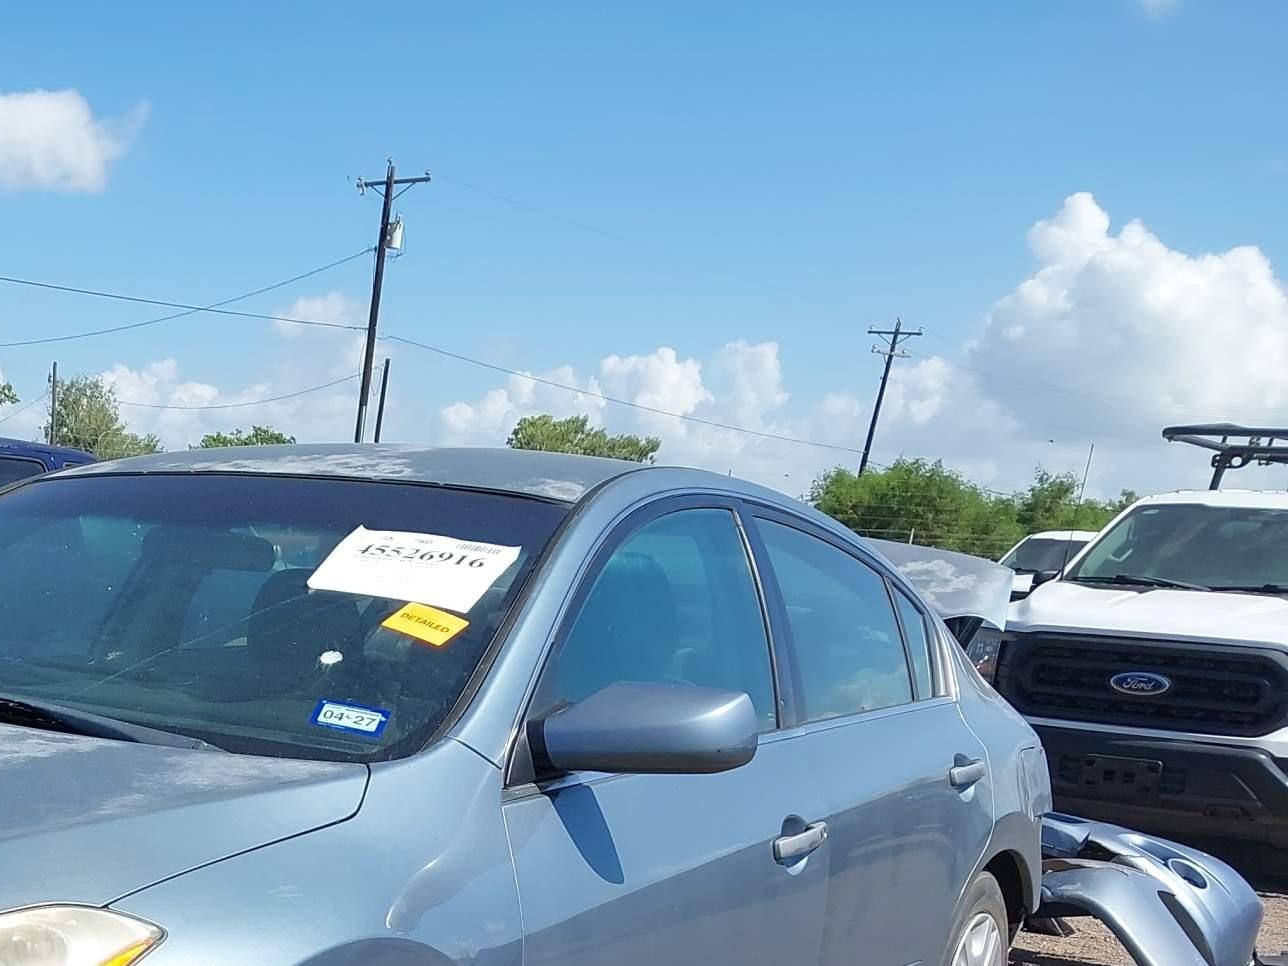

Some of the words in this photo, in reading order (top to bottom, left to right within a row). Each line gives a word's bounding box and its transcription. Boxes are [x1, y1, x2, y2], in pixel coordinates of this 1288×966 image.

[359, 543, 485, 568] 45526916
[399, 612, 450, 634] DETAILED
[1122, 676, 1155, 690] Ford
